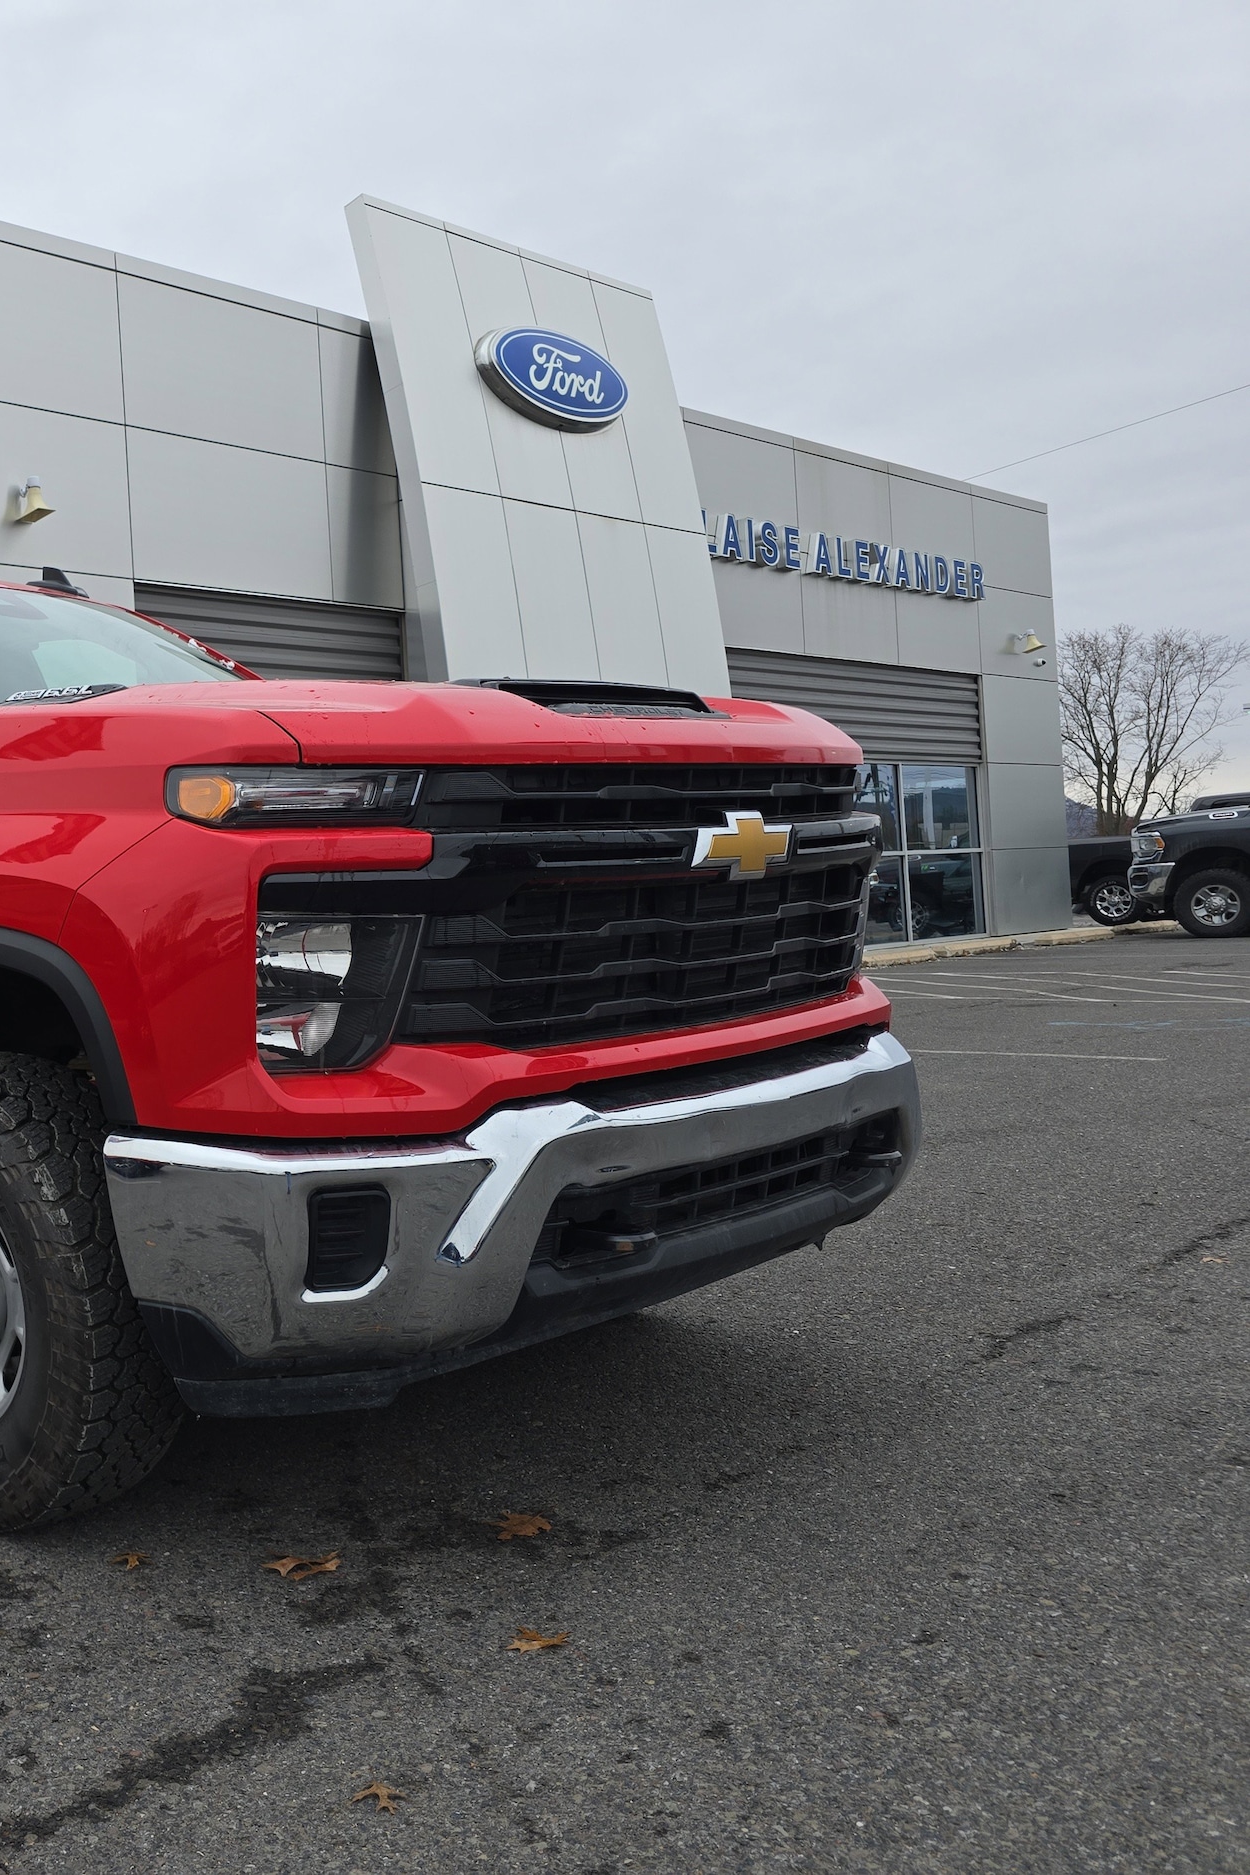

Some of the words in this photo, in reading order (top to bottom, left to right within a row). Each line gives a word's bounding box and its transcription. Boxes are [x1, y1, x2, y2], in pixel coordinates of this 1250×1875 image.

[528, 342, 605, 406] Ford
[814, 531, 986, 600] ALEXANDER
[587, 705, 685, 717] CHEVROLET
